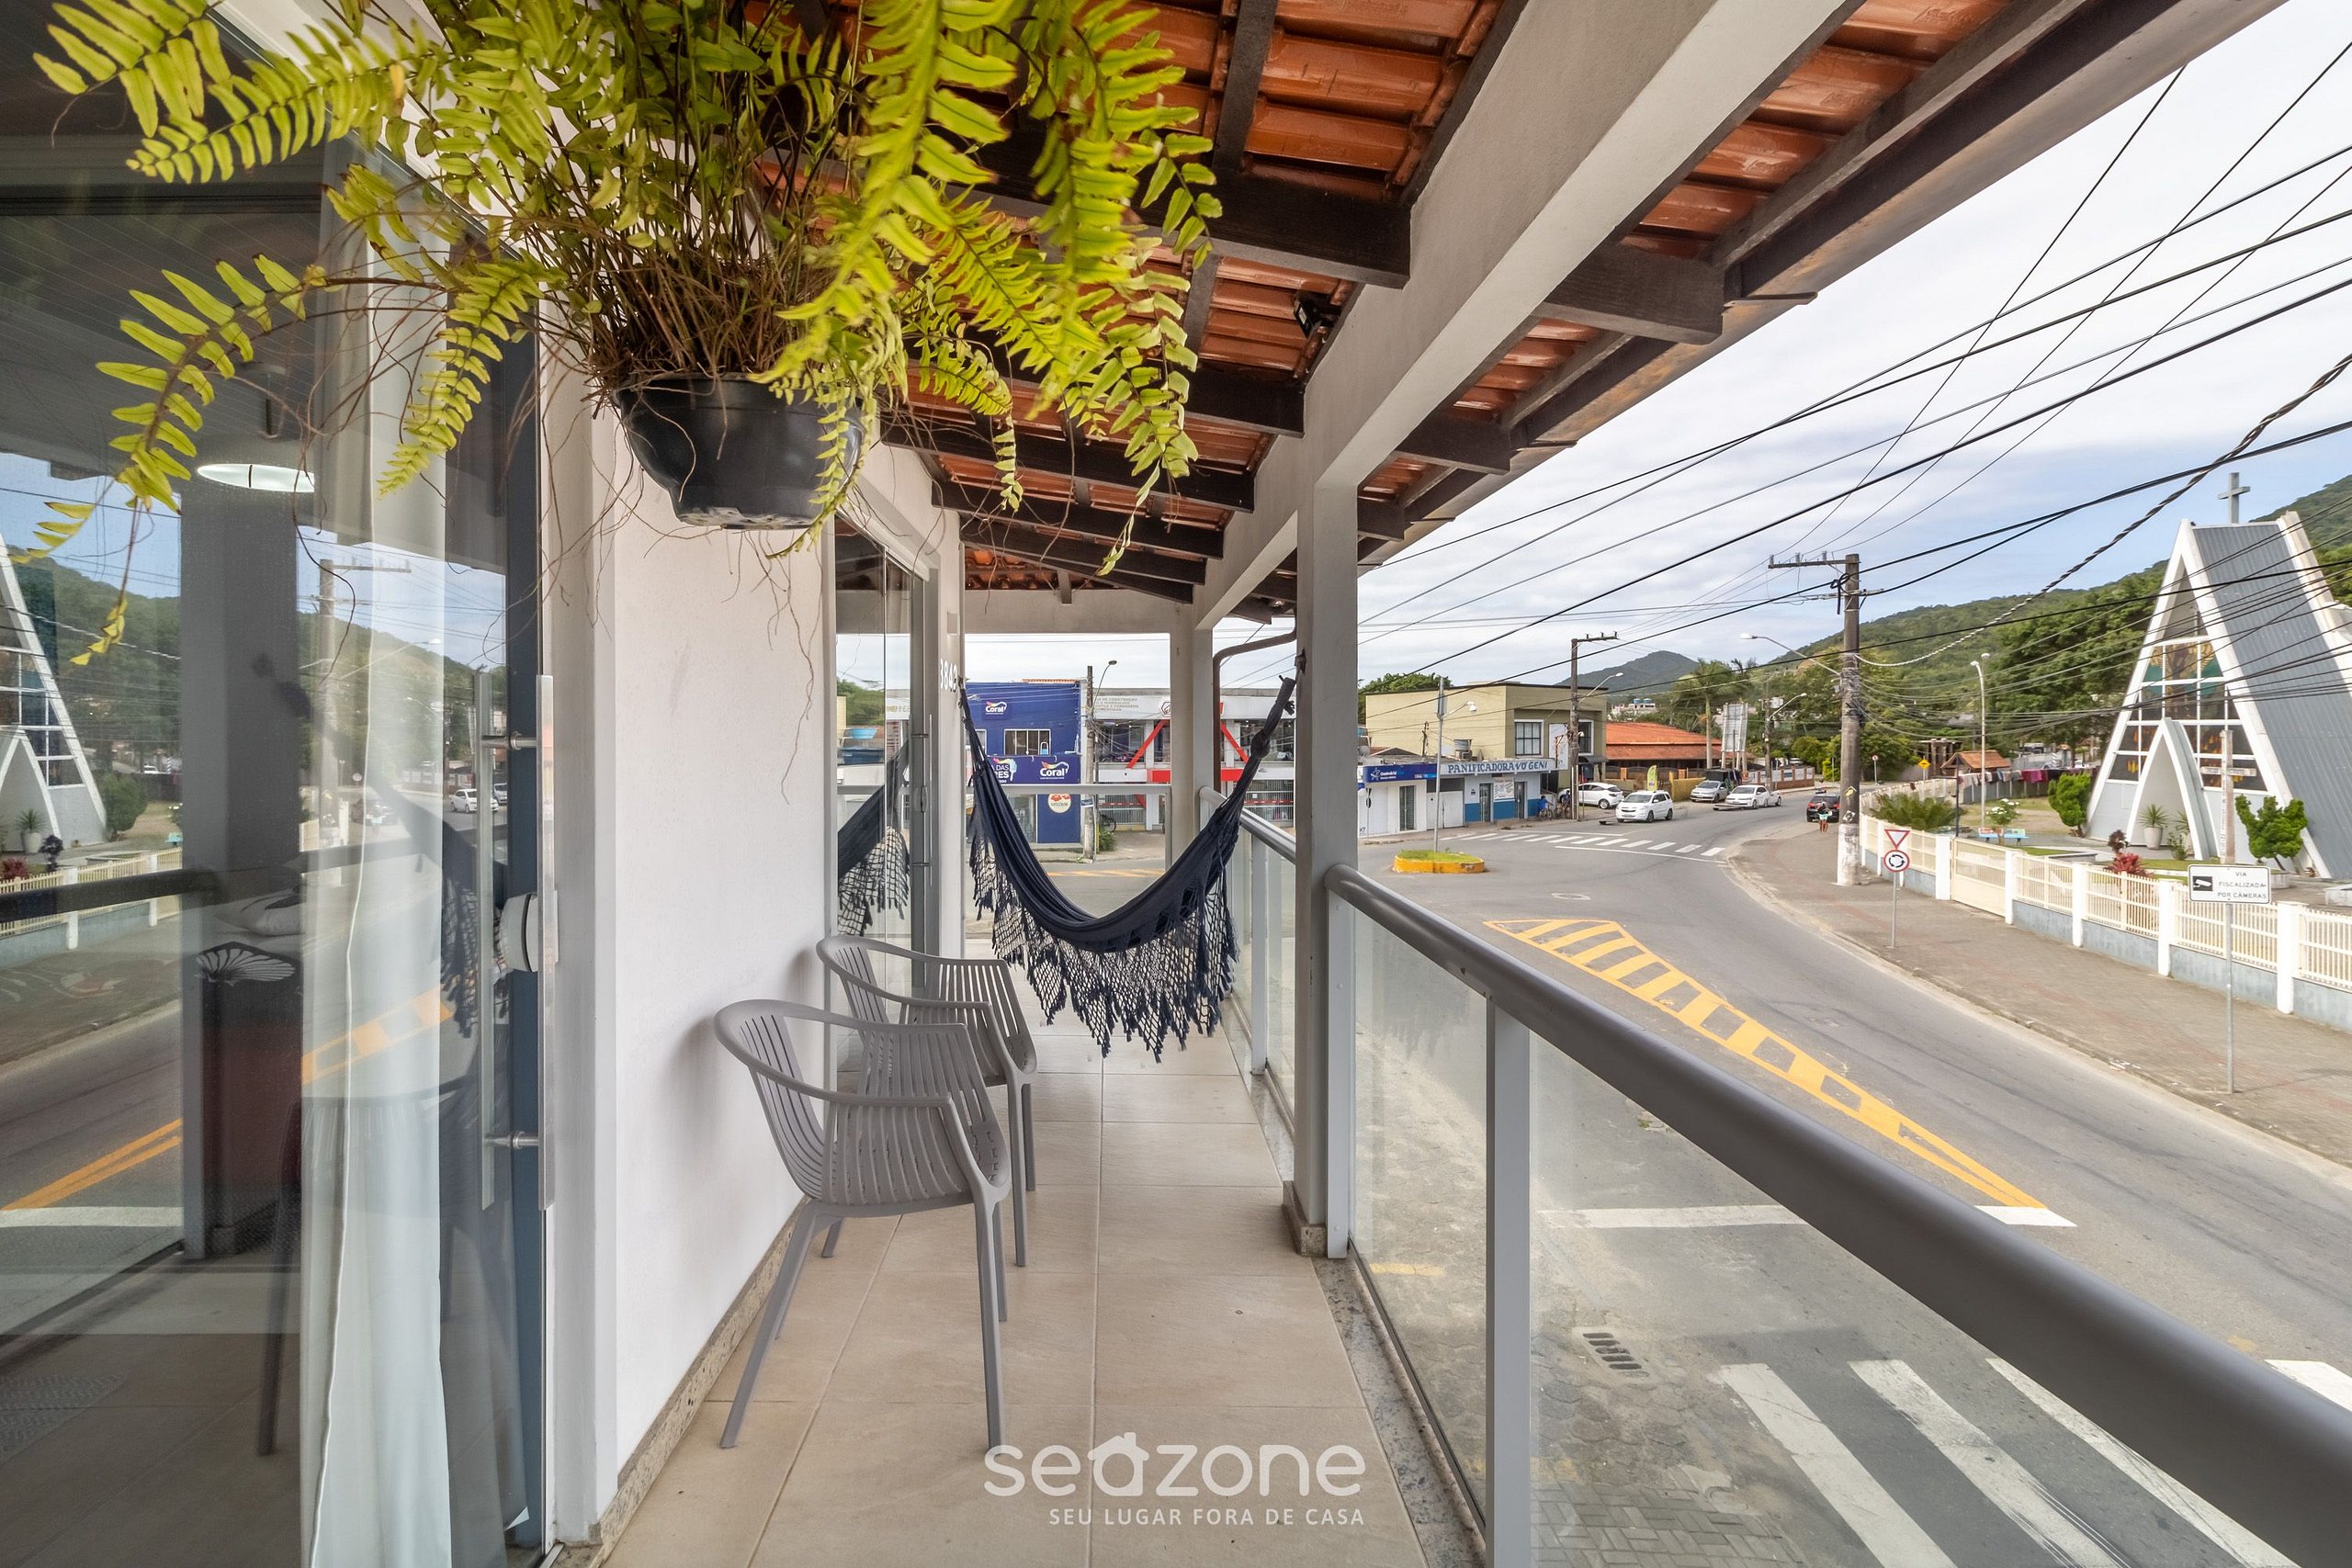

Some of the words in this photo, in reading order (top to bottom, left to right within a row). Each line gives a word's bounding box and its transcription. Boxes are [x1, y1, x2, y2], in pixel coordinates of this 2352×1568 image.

[1448, 762, 1514, 773] PANIFICADORA
[1528, 761, 1548, 770] GENI
[1039, 768, 1065, 777] Coral
